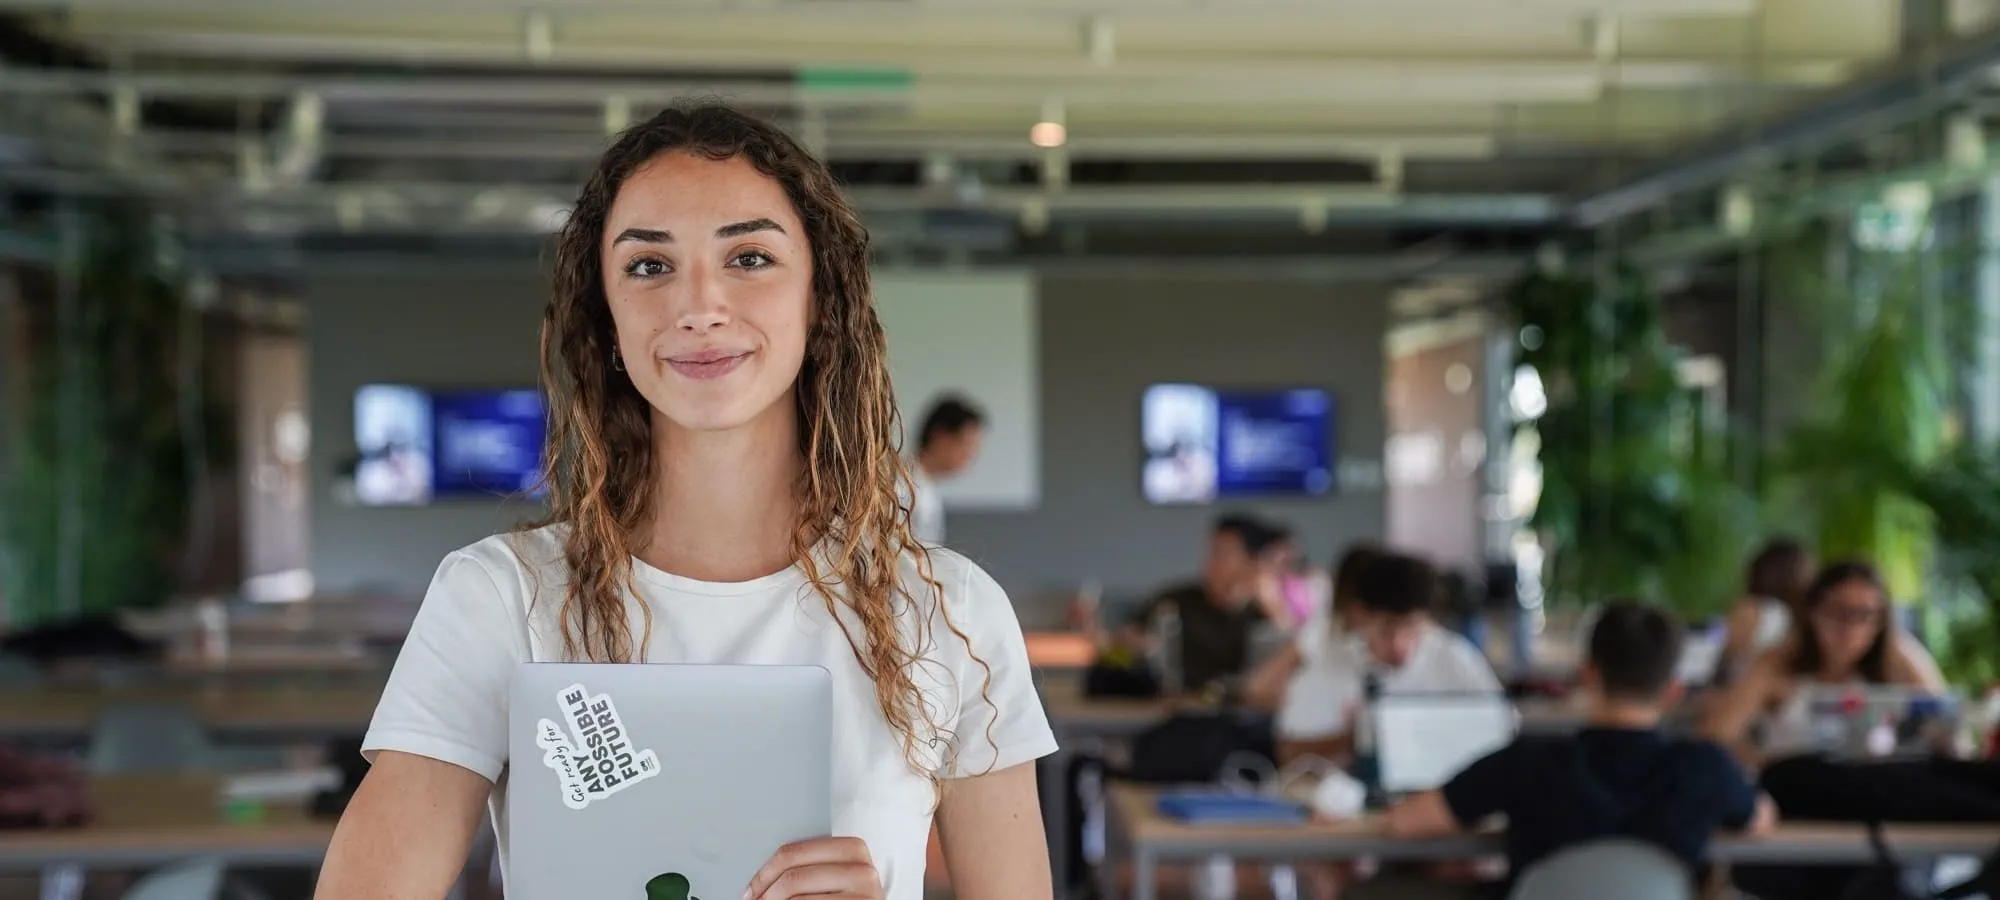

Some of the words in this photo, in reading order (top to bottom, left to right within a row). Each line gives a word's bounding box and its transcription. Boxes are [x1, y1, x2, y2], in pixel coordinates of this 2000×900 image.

[543, 726, 562, 742] for
[565, 690, 621, 788] POSSIBLE
[590, 700, 639, 780] FUTURE
[552, 746, 575, 778] ready
[572, 755, 605, 793] ANY
[570, 783, 585, 802] Get
